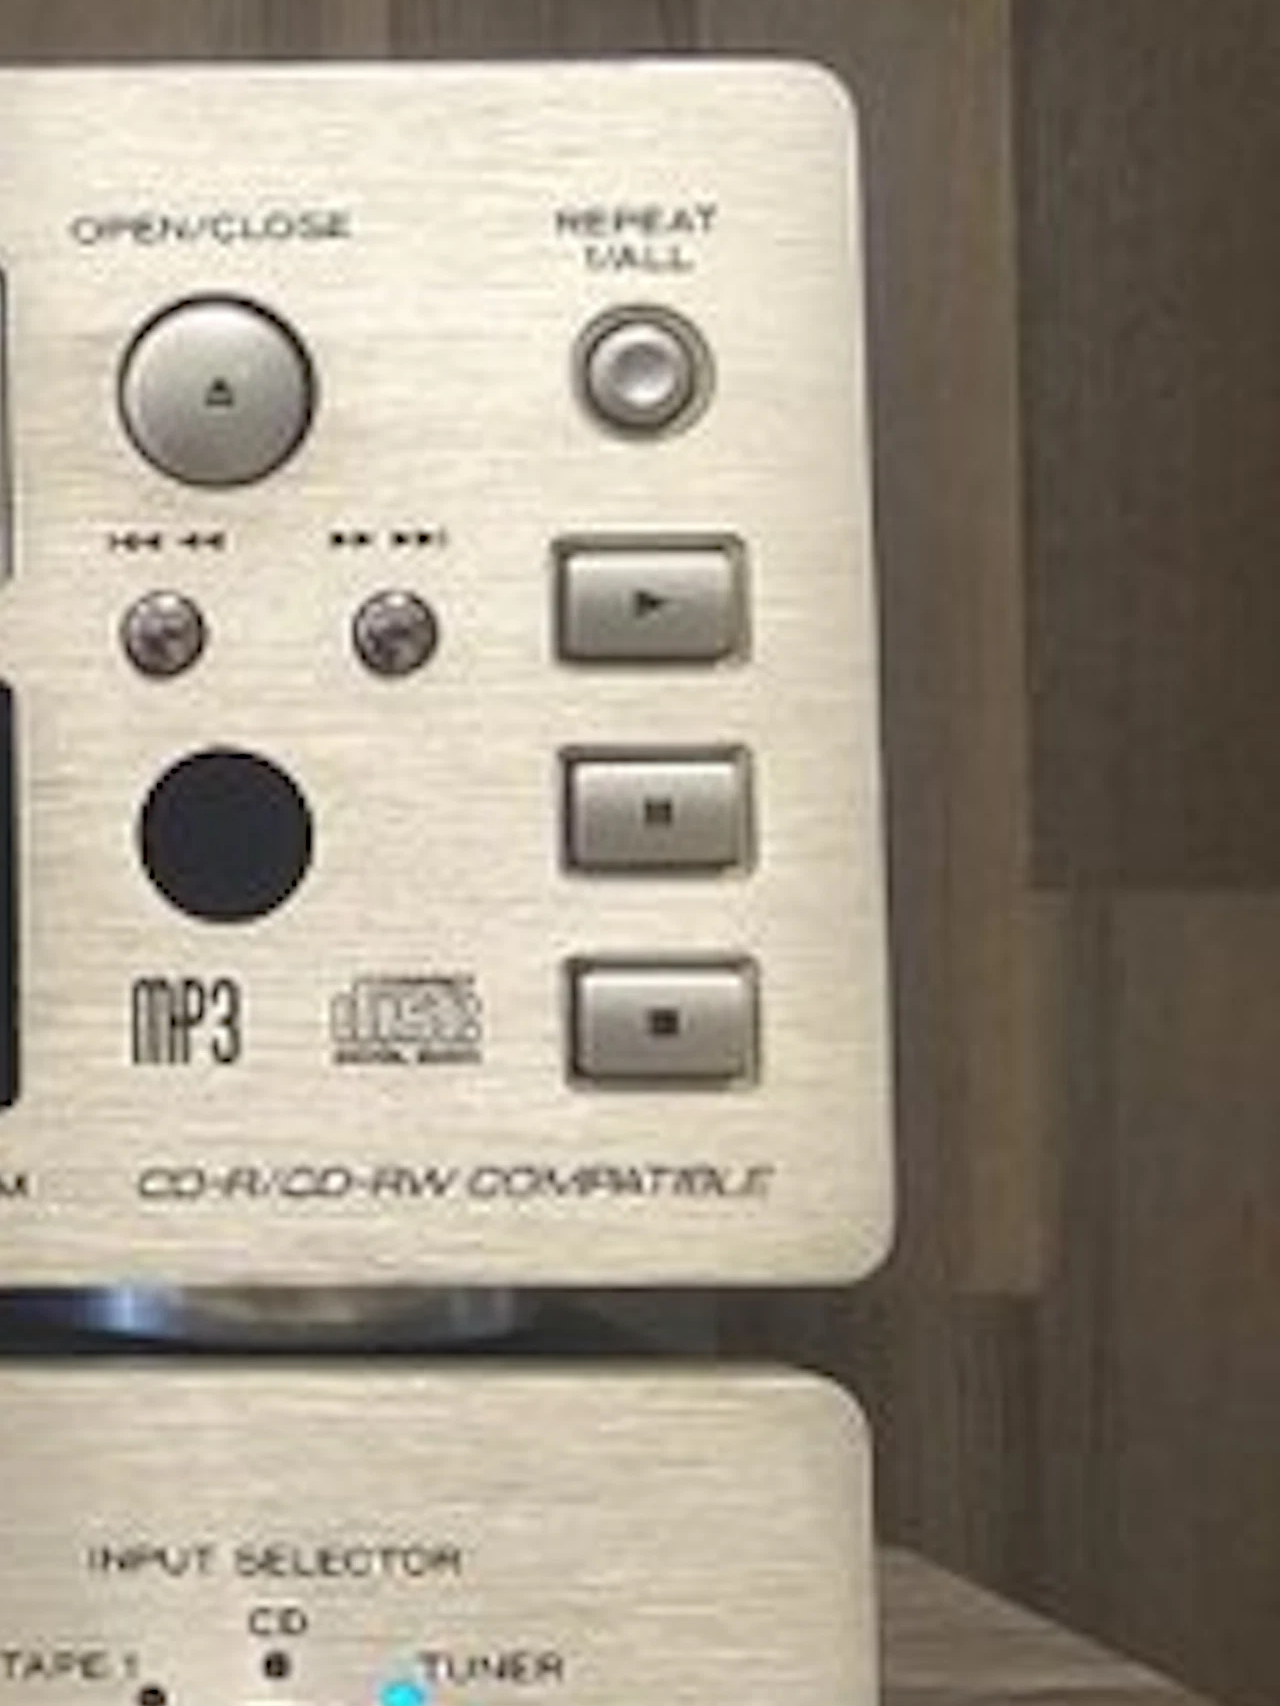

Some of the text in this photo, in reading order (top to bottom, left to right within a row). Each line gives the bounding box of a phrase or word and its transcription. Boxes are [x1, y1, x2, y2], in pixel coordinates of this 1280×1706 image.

[70, 211, 352, 245] OPEN/CLOSE
[555, 202, 718, 238] REPEAT
[132, 976, 240, 1065] MP3
[466, 1165, 775, 1199] COMPATIBLE
[88, 1545, 463, 1578] INPUT SELECTOR
[248, 1609, 309, 1637] CD
[1, 1650, 120, 1680] TAPE
[420, 1653, 563, 1682] TUNER
